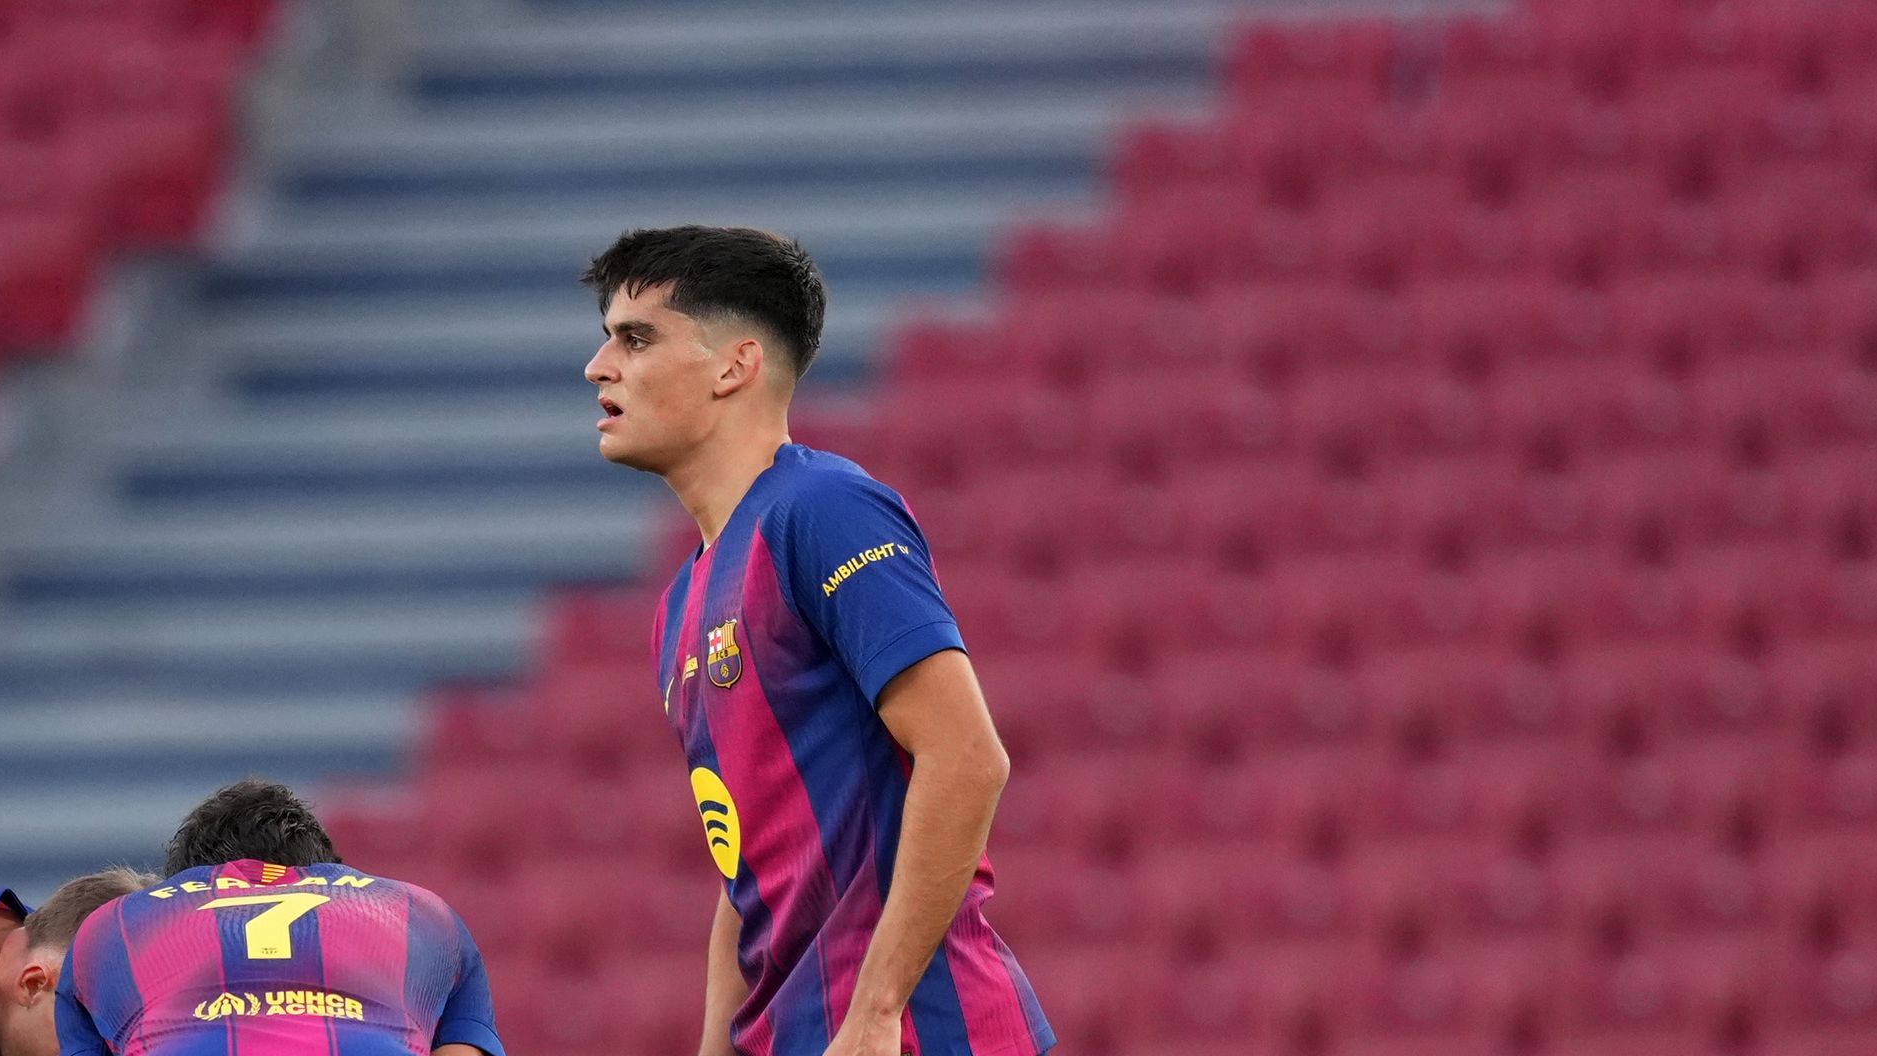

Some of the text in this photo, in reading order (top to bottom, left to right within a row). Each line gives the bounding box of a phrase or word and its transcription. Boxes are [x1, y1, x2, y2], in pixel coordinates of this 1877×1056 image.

[822, 542, 894, 597] AMBILIGHT
[148, 875, 375, 899] FERAN
[196, 892, 331, 959] 7
[264, 990, 364, 1012] UNHCR
